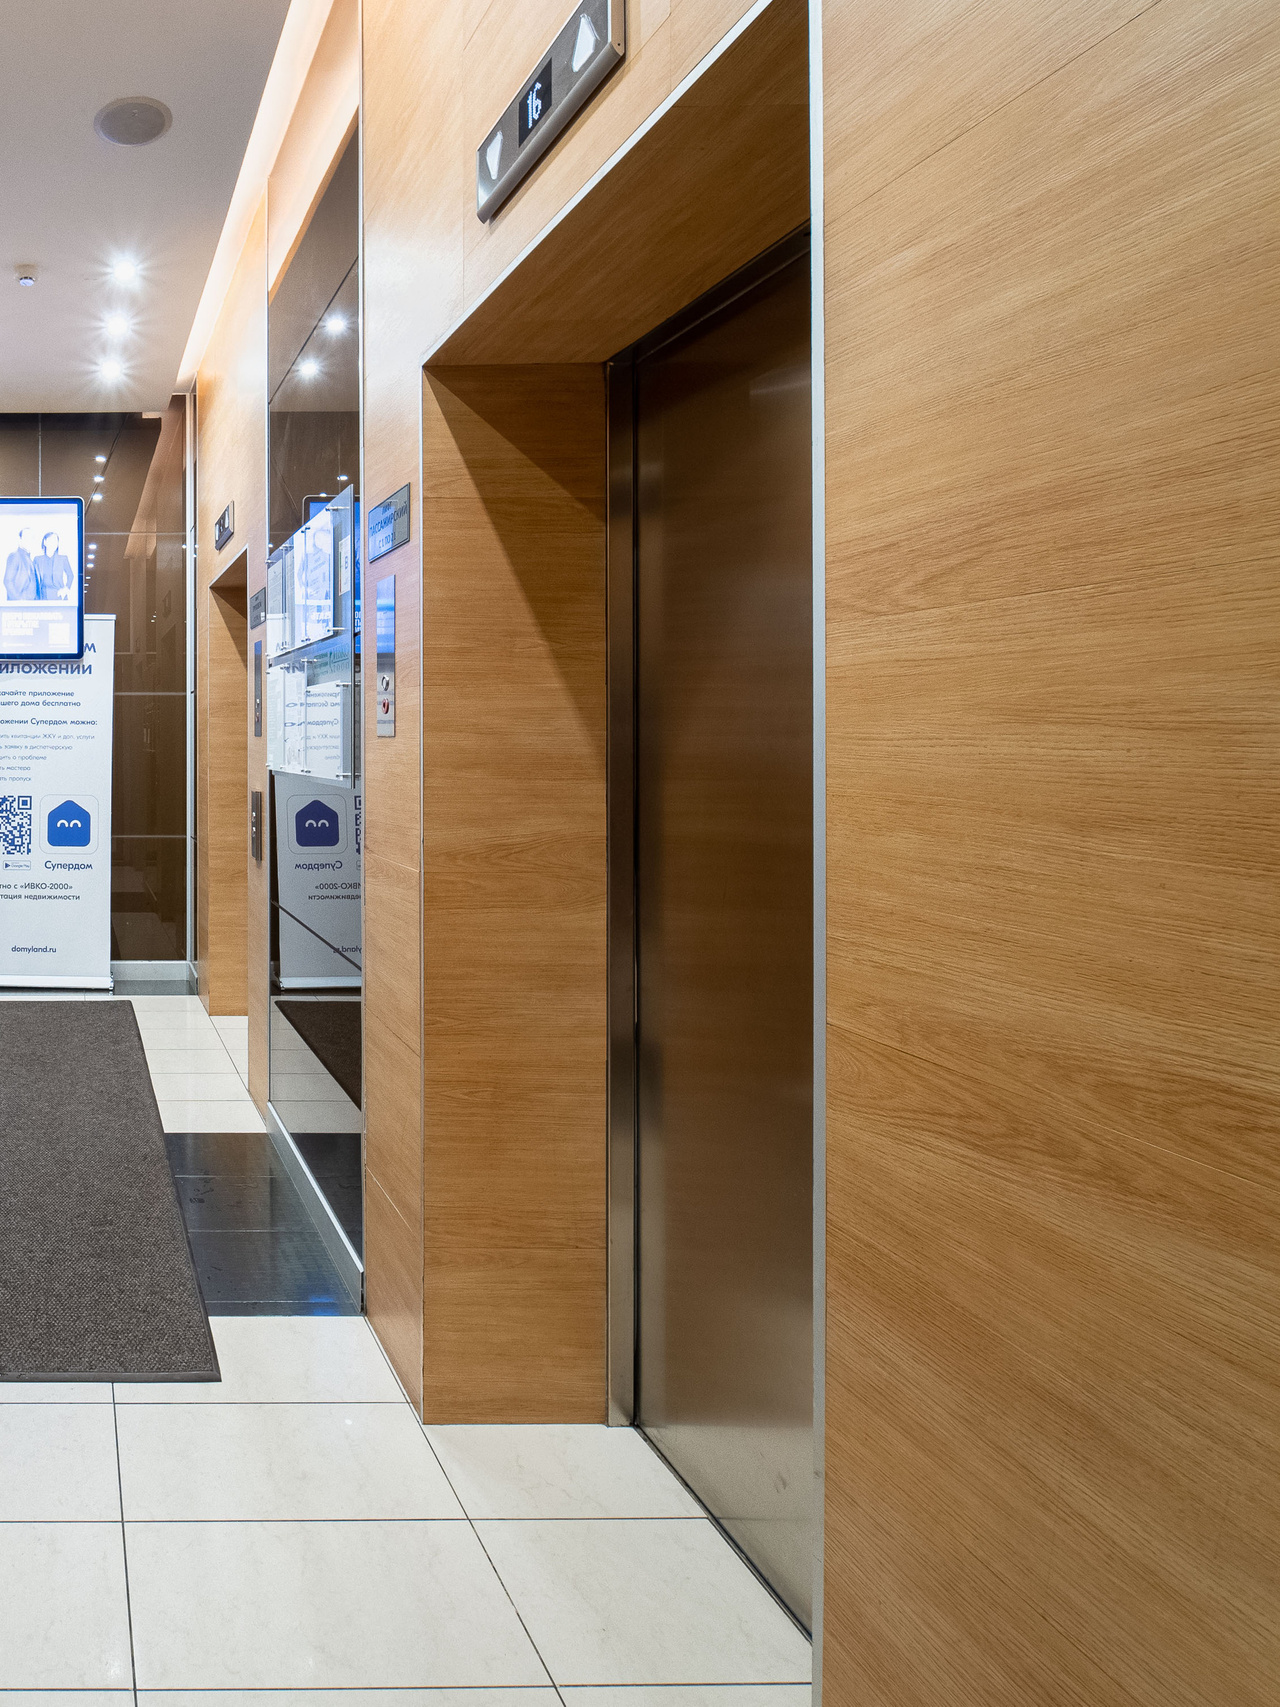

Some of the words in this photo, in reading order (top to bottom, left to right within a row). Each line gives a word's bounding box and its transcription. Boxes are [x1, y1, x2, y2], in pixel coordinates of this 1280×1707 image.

[527, 82, 542, 129] 16
[42, 699, 81, 707] бесплатно
[30, 717, 68, 725] Супердом
[44, 860, 93, 871] Супердом
[20, 882, 73, 890] «ИВКО-2000»
[11, 945, 57, 954] domyland.ru
